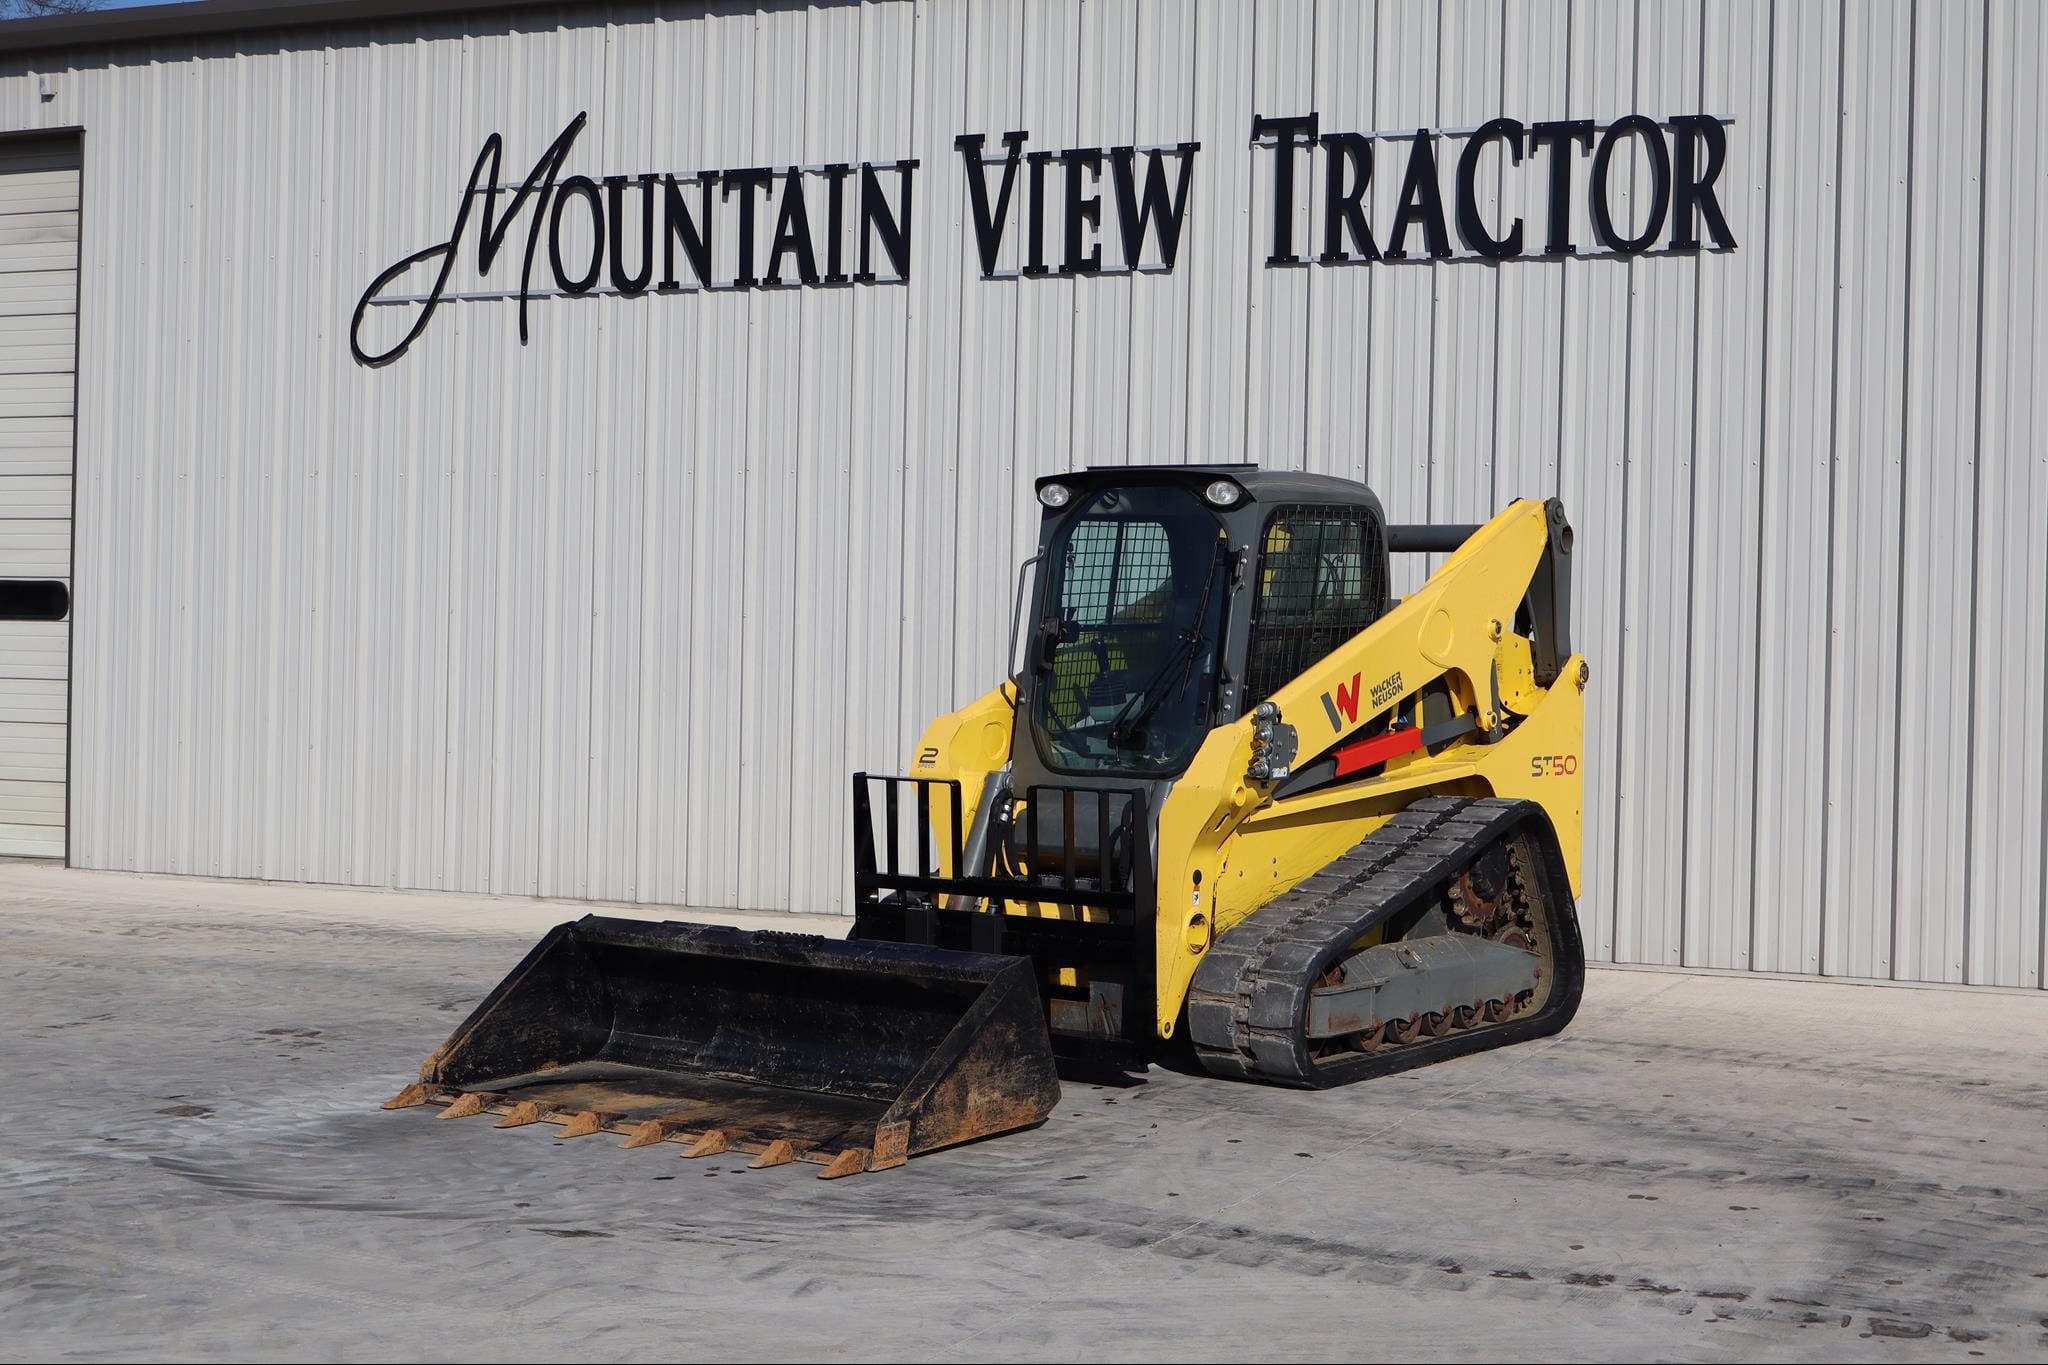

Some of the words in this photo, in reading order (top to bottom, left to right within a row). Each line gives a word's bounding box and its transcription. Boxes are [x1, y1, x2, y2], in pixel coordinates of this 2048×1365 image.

[351, 111, 920, 366] MOUNTAIN
[954, 131, 1200, 277] VIEW
[1253, 111, 1737, 264] TRACTOR
[1370, 671, 1402, 697] WACKER
[1371, 681, 1404, 709] NEUSON
[919, 747, 939, 764] 2
[1531, 754, 1578, 777] ST50
